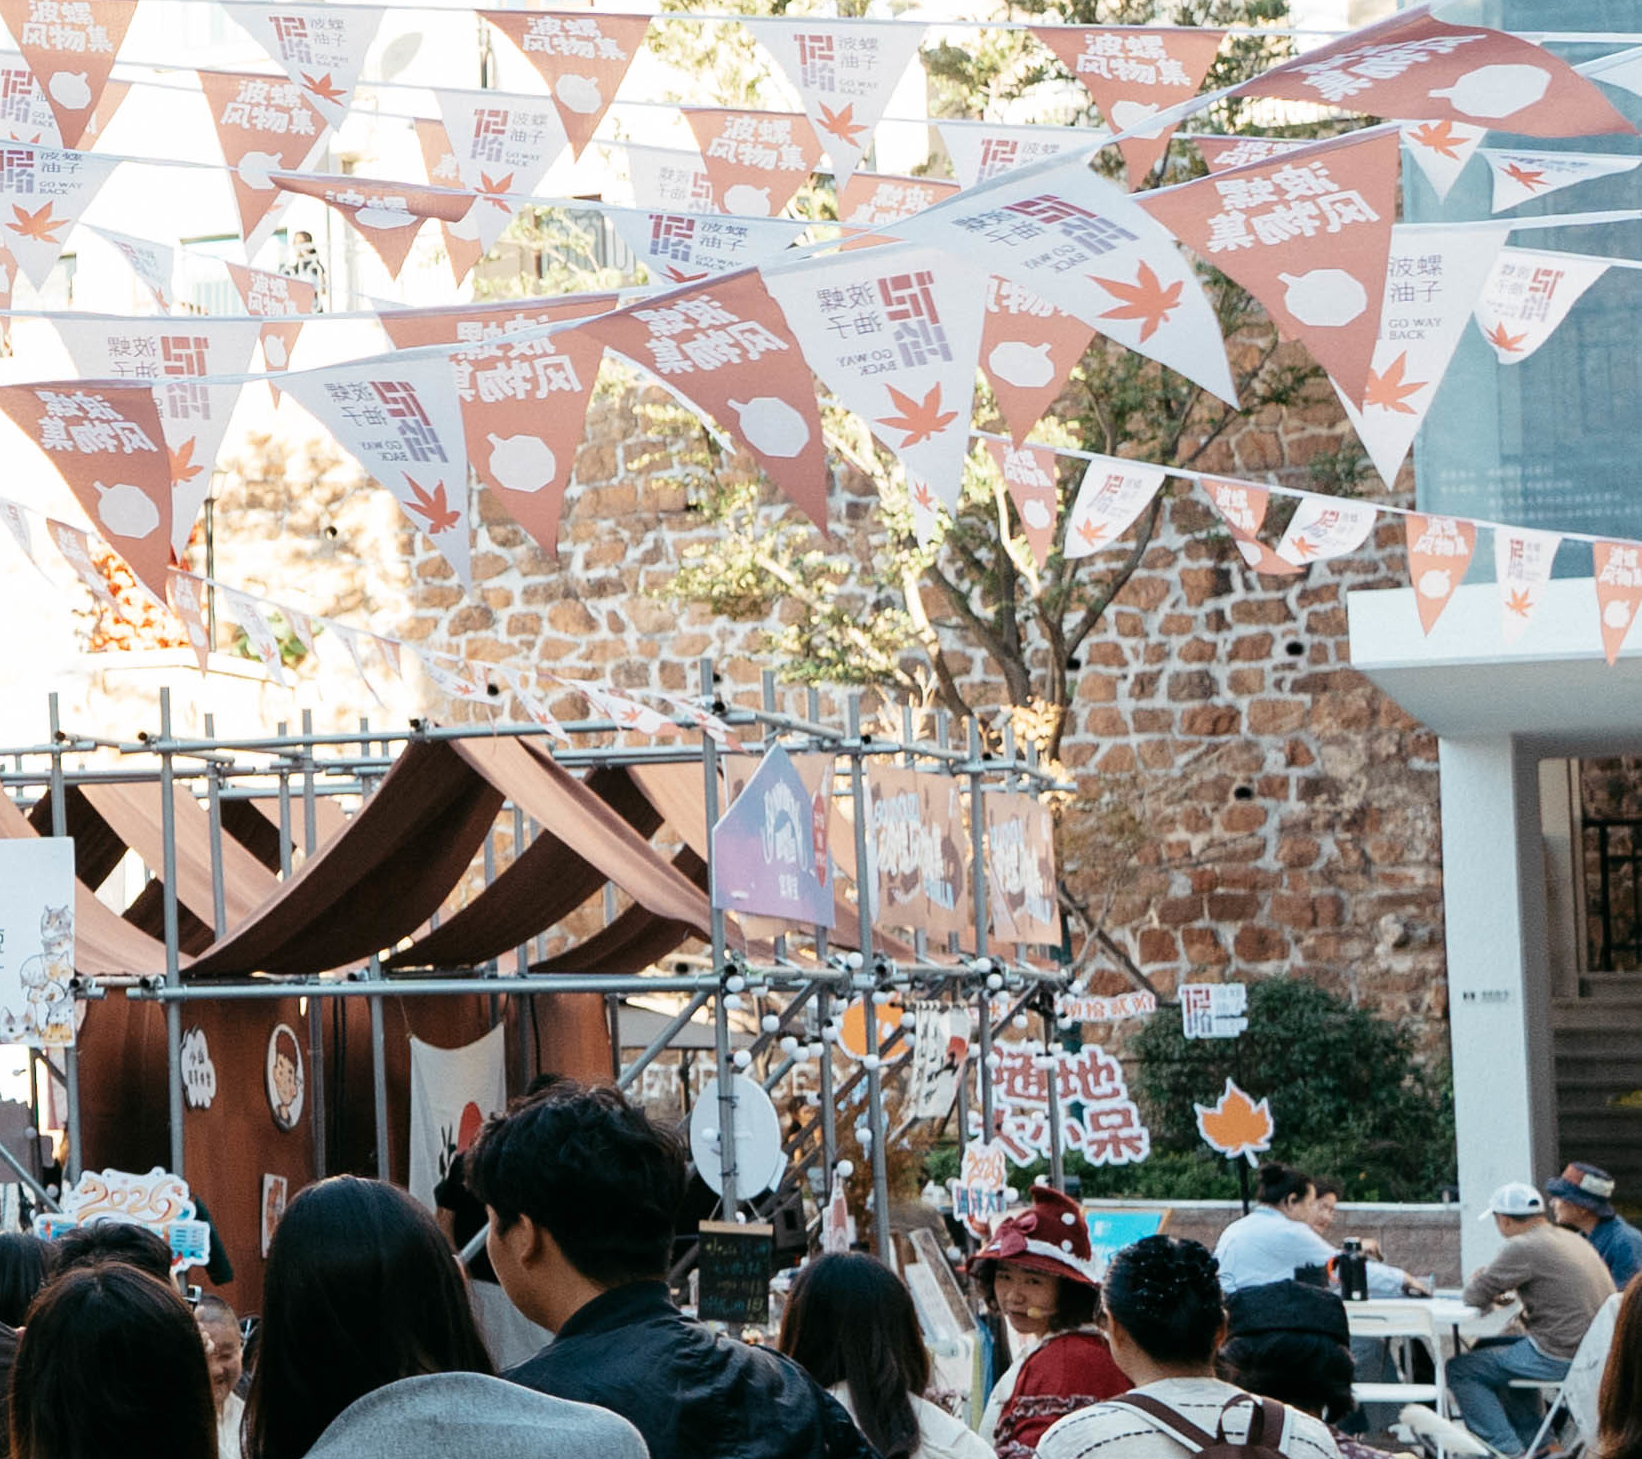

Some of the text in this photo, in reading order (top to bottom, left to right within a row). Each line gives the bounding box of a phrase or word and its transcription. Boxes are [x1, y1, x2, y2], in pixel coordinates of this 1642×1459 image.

[29, 0, 91, 27] 波螺
[21, 23, 112, 52] 风物集
[236, 80, 302, 110] 波螺
[221, 102, 316, 135] 风物集
[724, 116, 791, 141] 波螺
[707, 139, 807, 171] 风物集
[1388, 255, 1443, 277] 波螺
[1390, 280, 1443, 303] 油子
[1388, 318, 1443, 328] GO WAY
[1388, 329, 1425, 340] BACK
[78, 1180, 180, 1224] 2026
